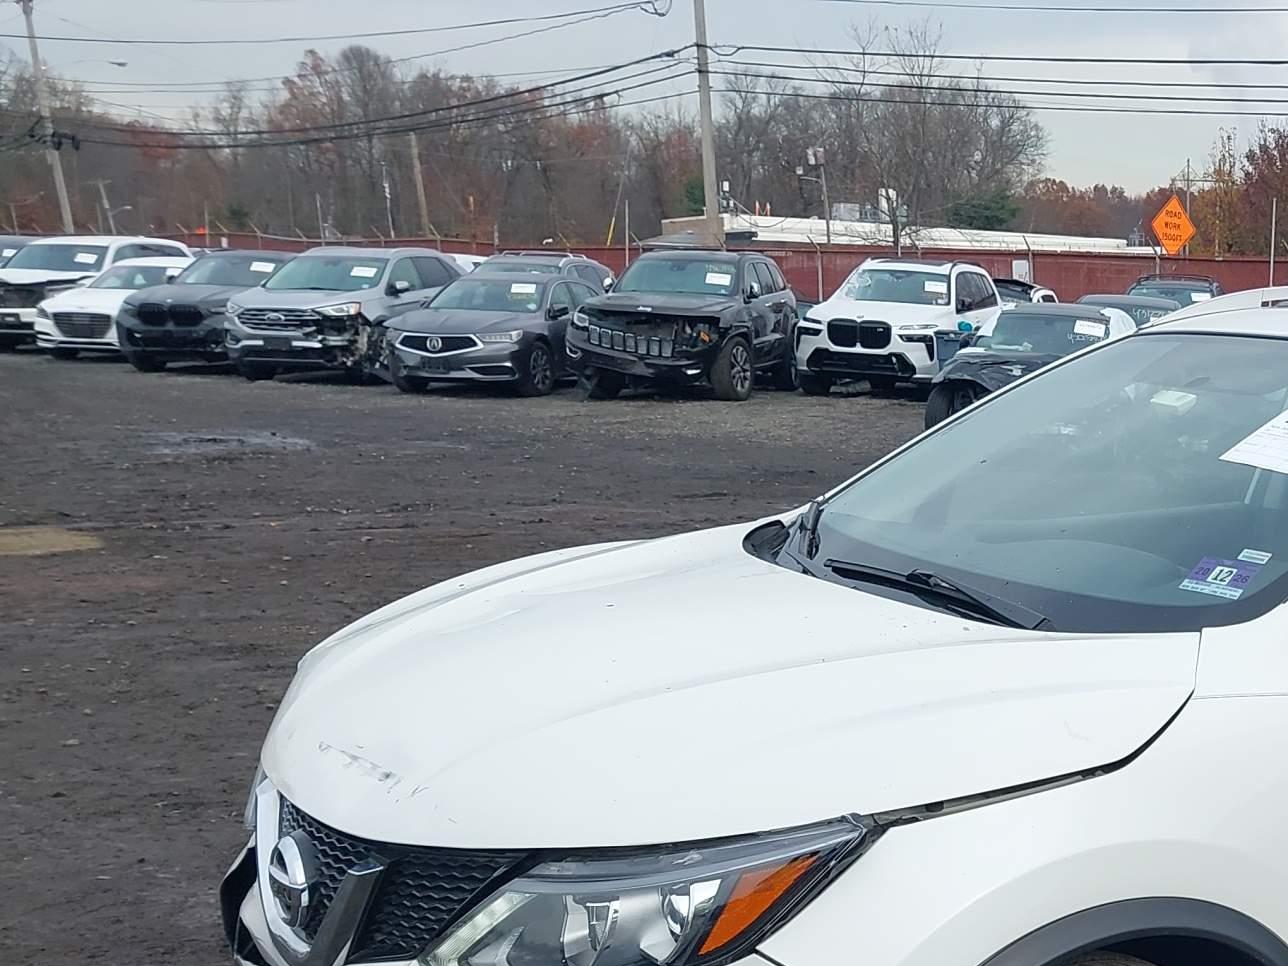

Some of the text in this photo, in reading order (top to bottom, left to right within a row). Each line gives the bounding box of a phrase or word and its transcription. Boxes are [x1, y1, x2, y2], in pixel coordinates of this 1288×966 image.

[1164, 209, 1182, 220] ROAD
[1164, 221, 1182, 231] WORK
[1211, 568, 1233, 583] 12
